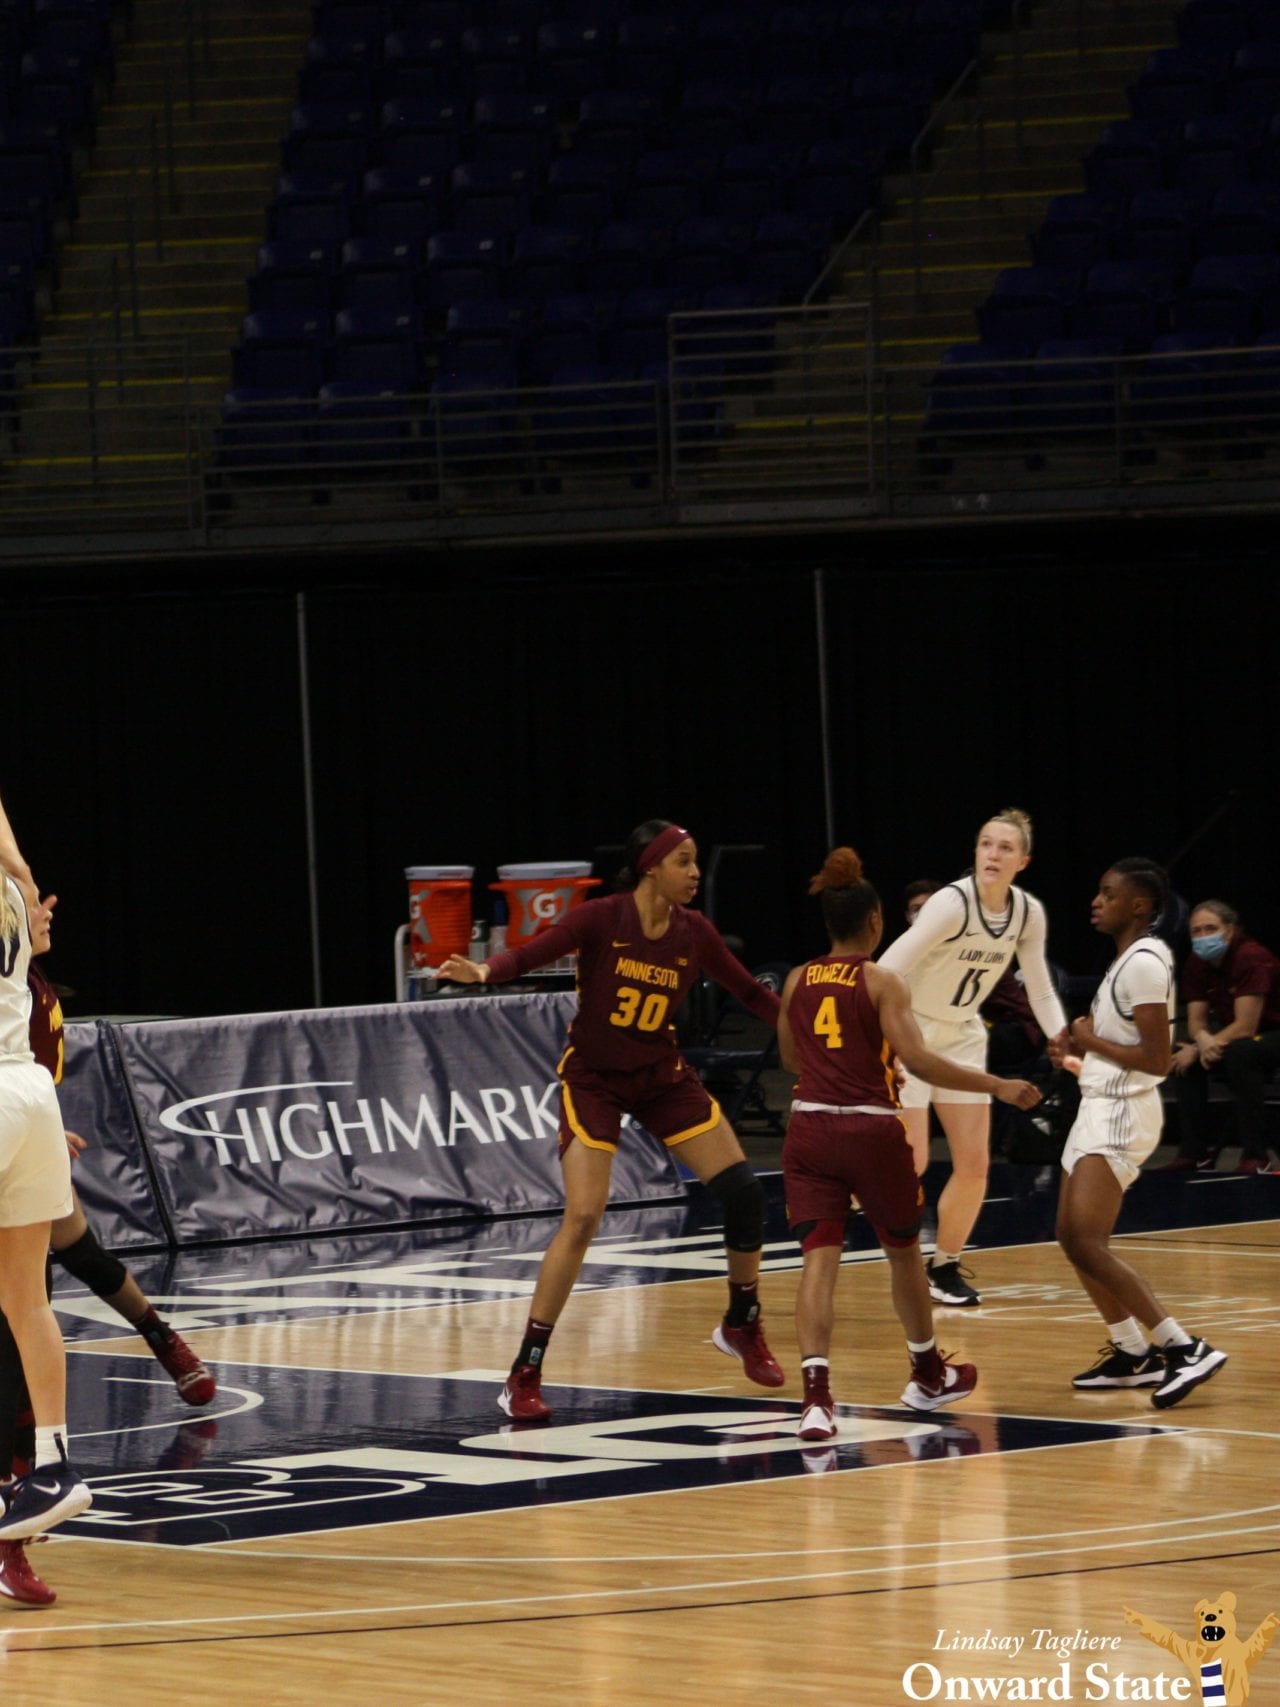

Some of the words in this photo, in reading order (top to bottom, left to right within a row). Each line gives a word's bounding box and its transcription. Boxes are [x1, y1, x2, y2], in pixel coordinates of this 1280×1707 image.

[533, 893, 556, 918] G
[615, 956, 680, 990] MINNESOTA
[949, 967, 990, 1007] 15
[609, 986, 670, 1031] 30
[813, 996, 842, 1048] 4
[206, 1081, 563, 1166] HIGHMARK
